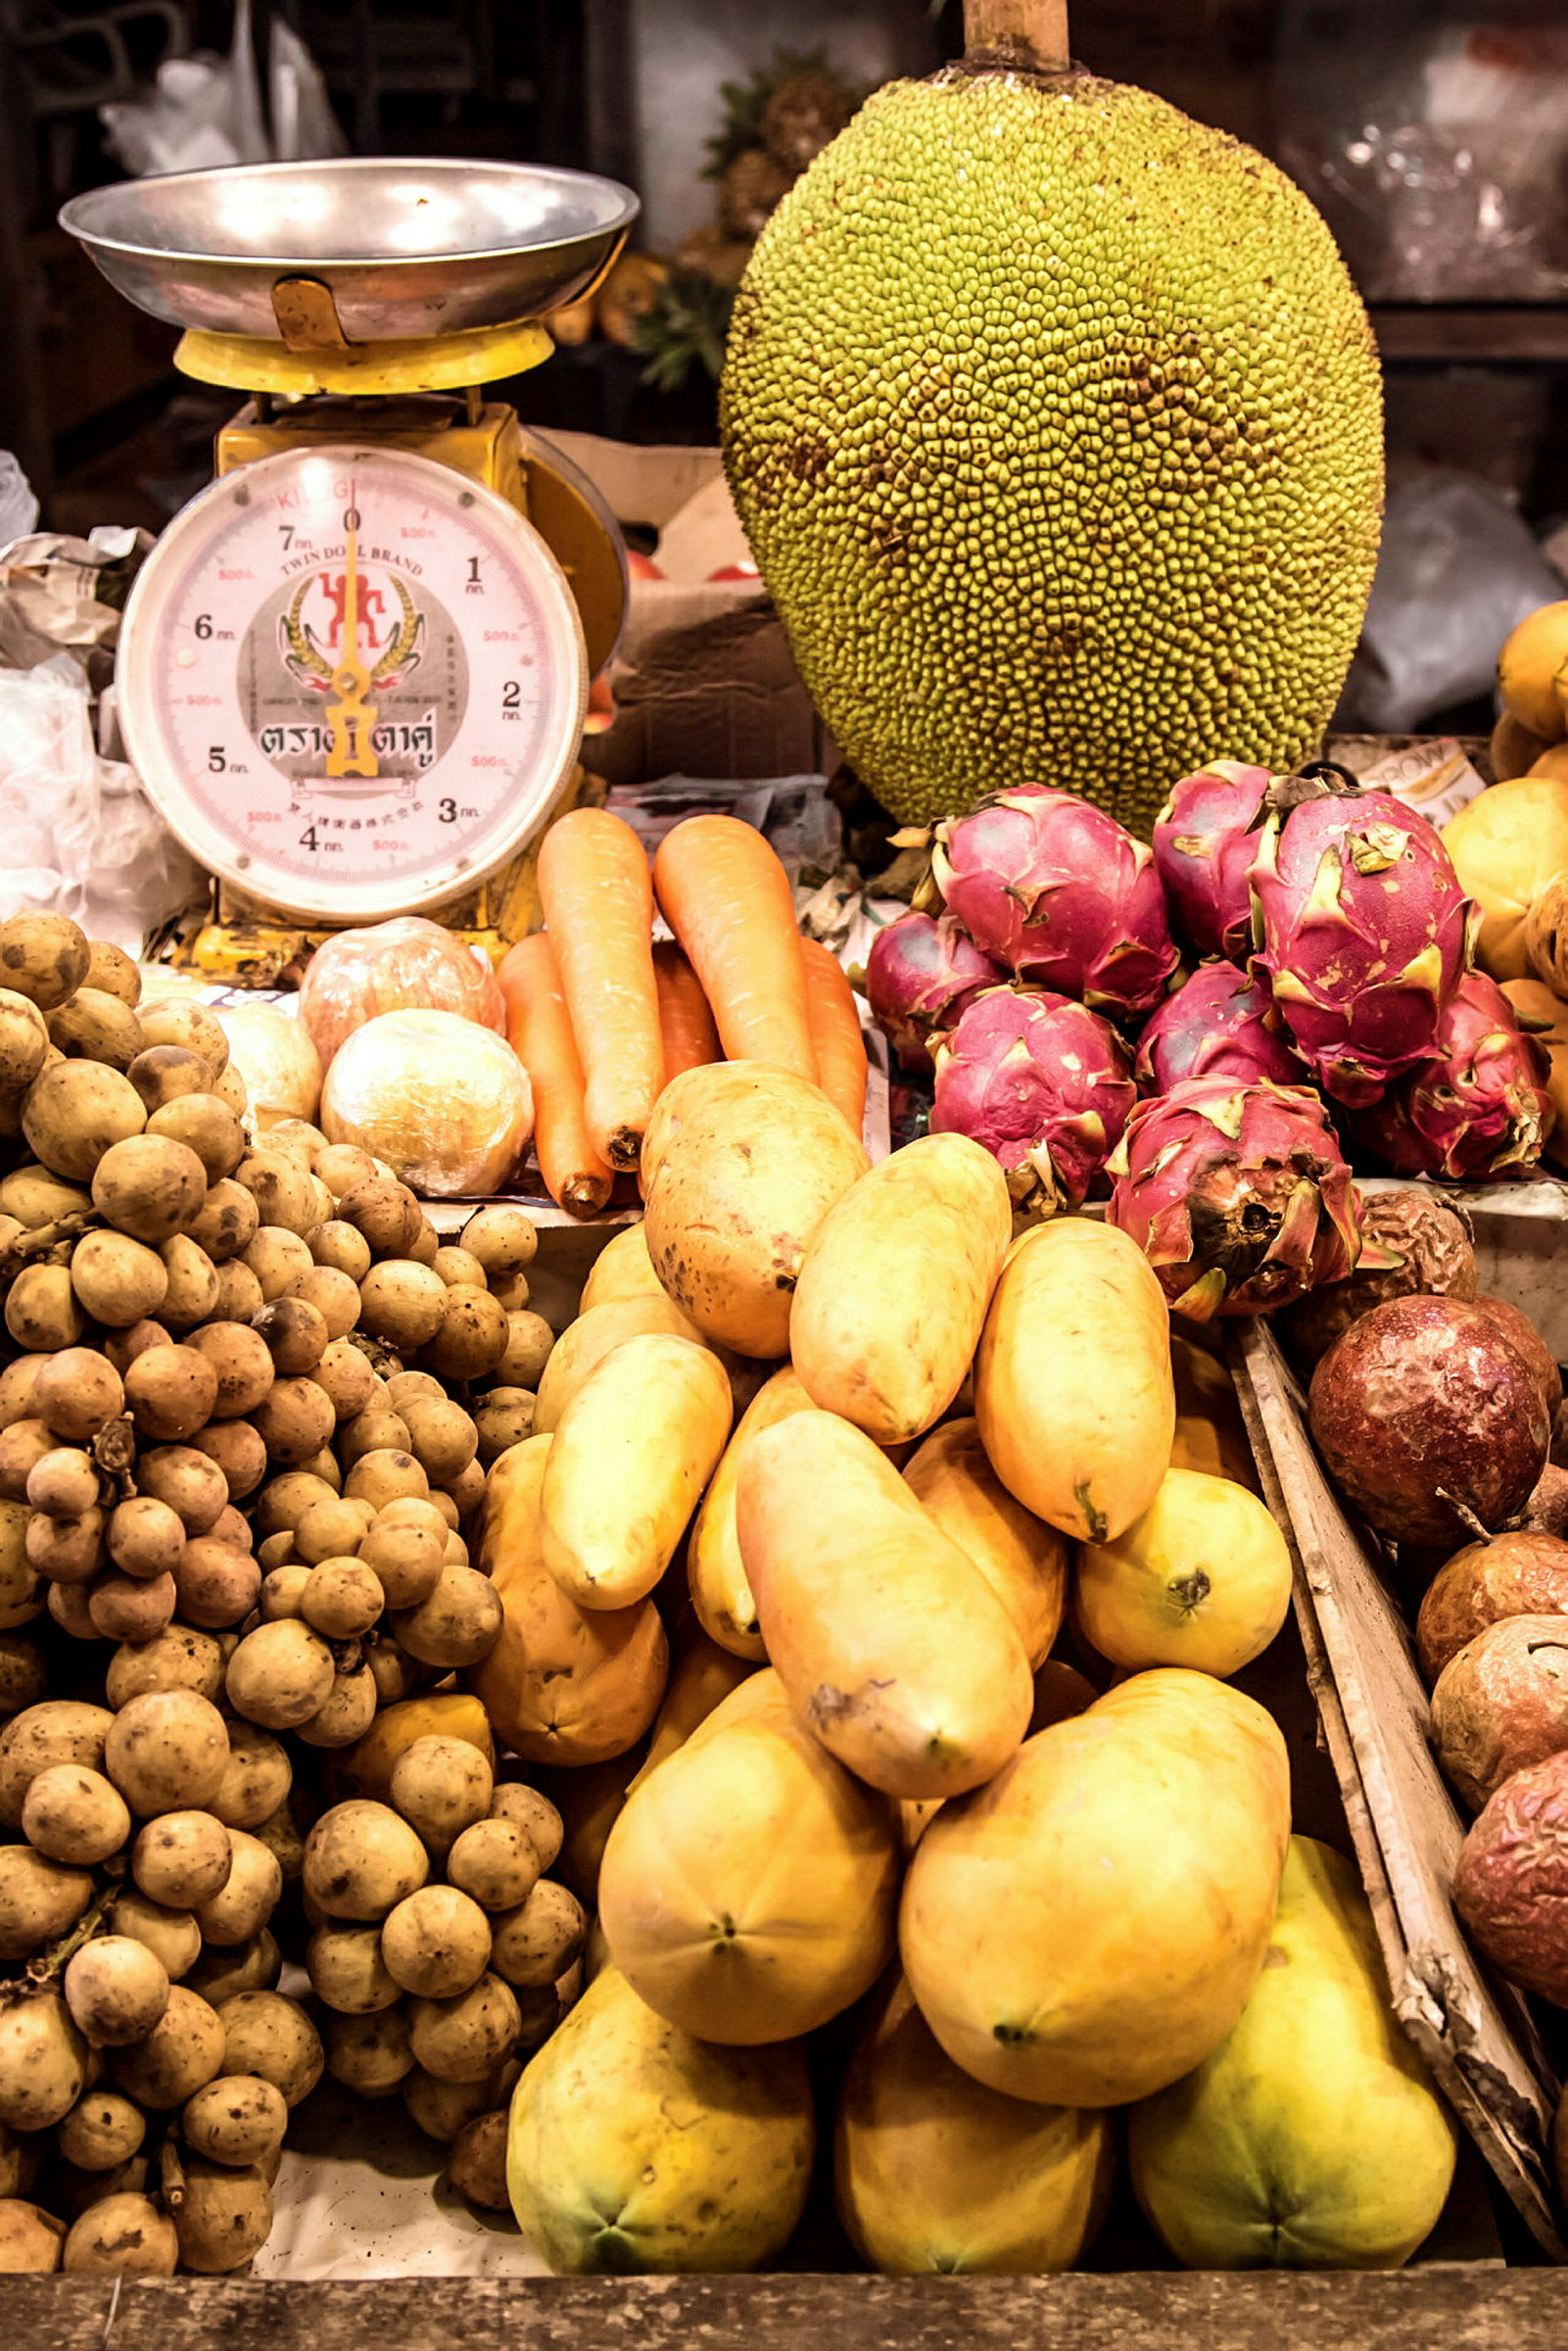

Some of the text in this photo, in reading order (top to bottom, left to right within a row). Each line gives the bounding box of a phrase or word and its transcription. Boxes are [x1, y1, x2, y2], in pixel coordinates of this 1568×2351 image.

[343, 507, 360, 532] 0
[278, 524, 295, 551] 7
[279, 544, 424, 577] TWIN DOL BRAND
[467, 555, 482, 583] 1
[194, 613, 213, 639] 6
[501, 681, 521, 707] 2
[208, 745, 226, 773] 5
[438, 797, 457, 823] 3
[299, 825, 320, 851] 4
